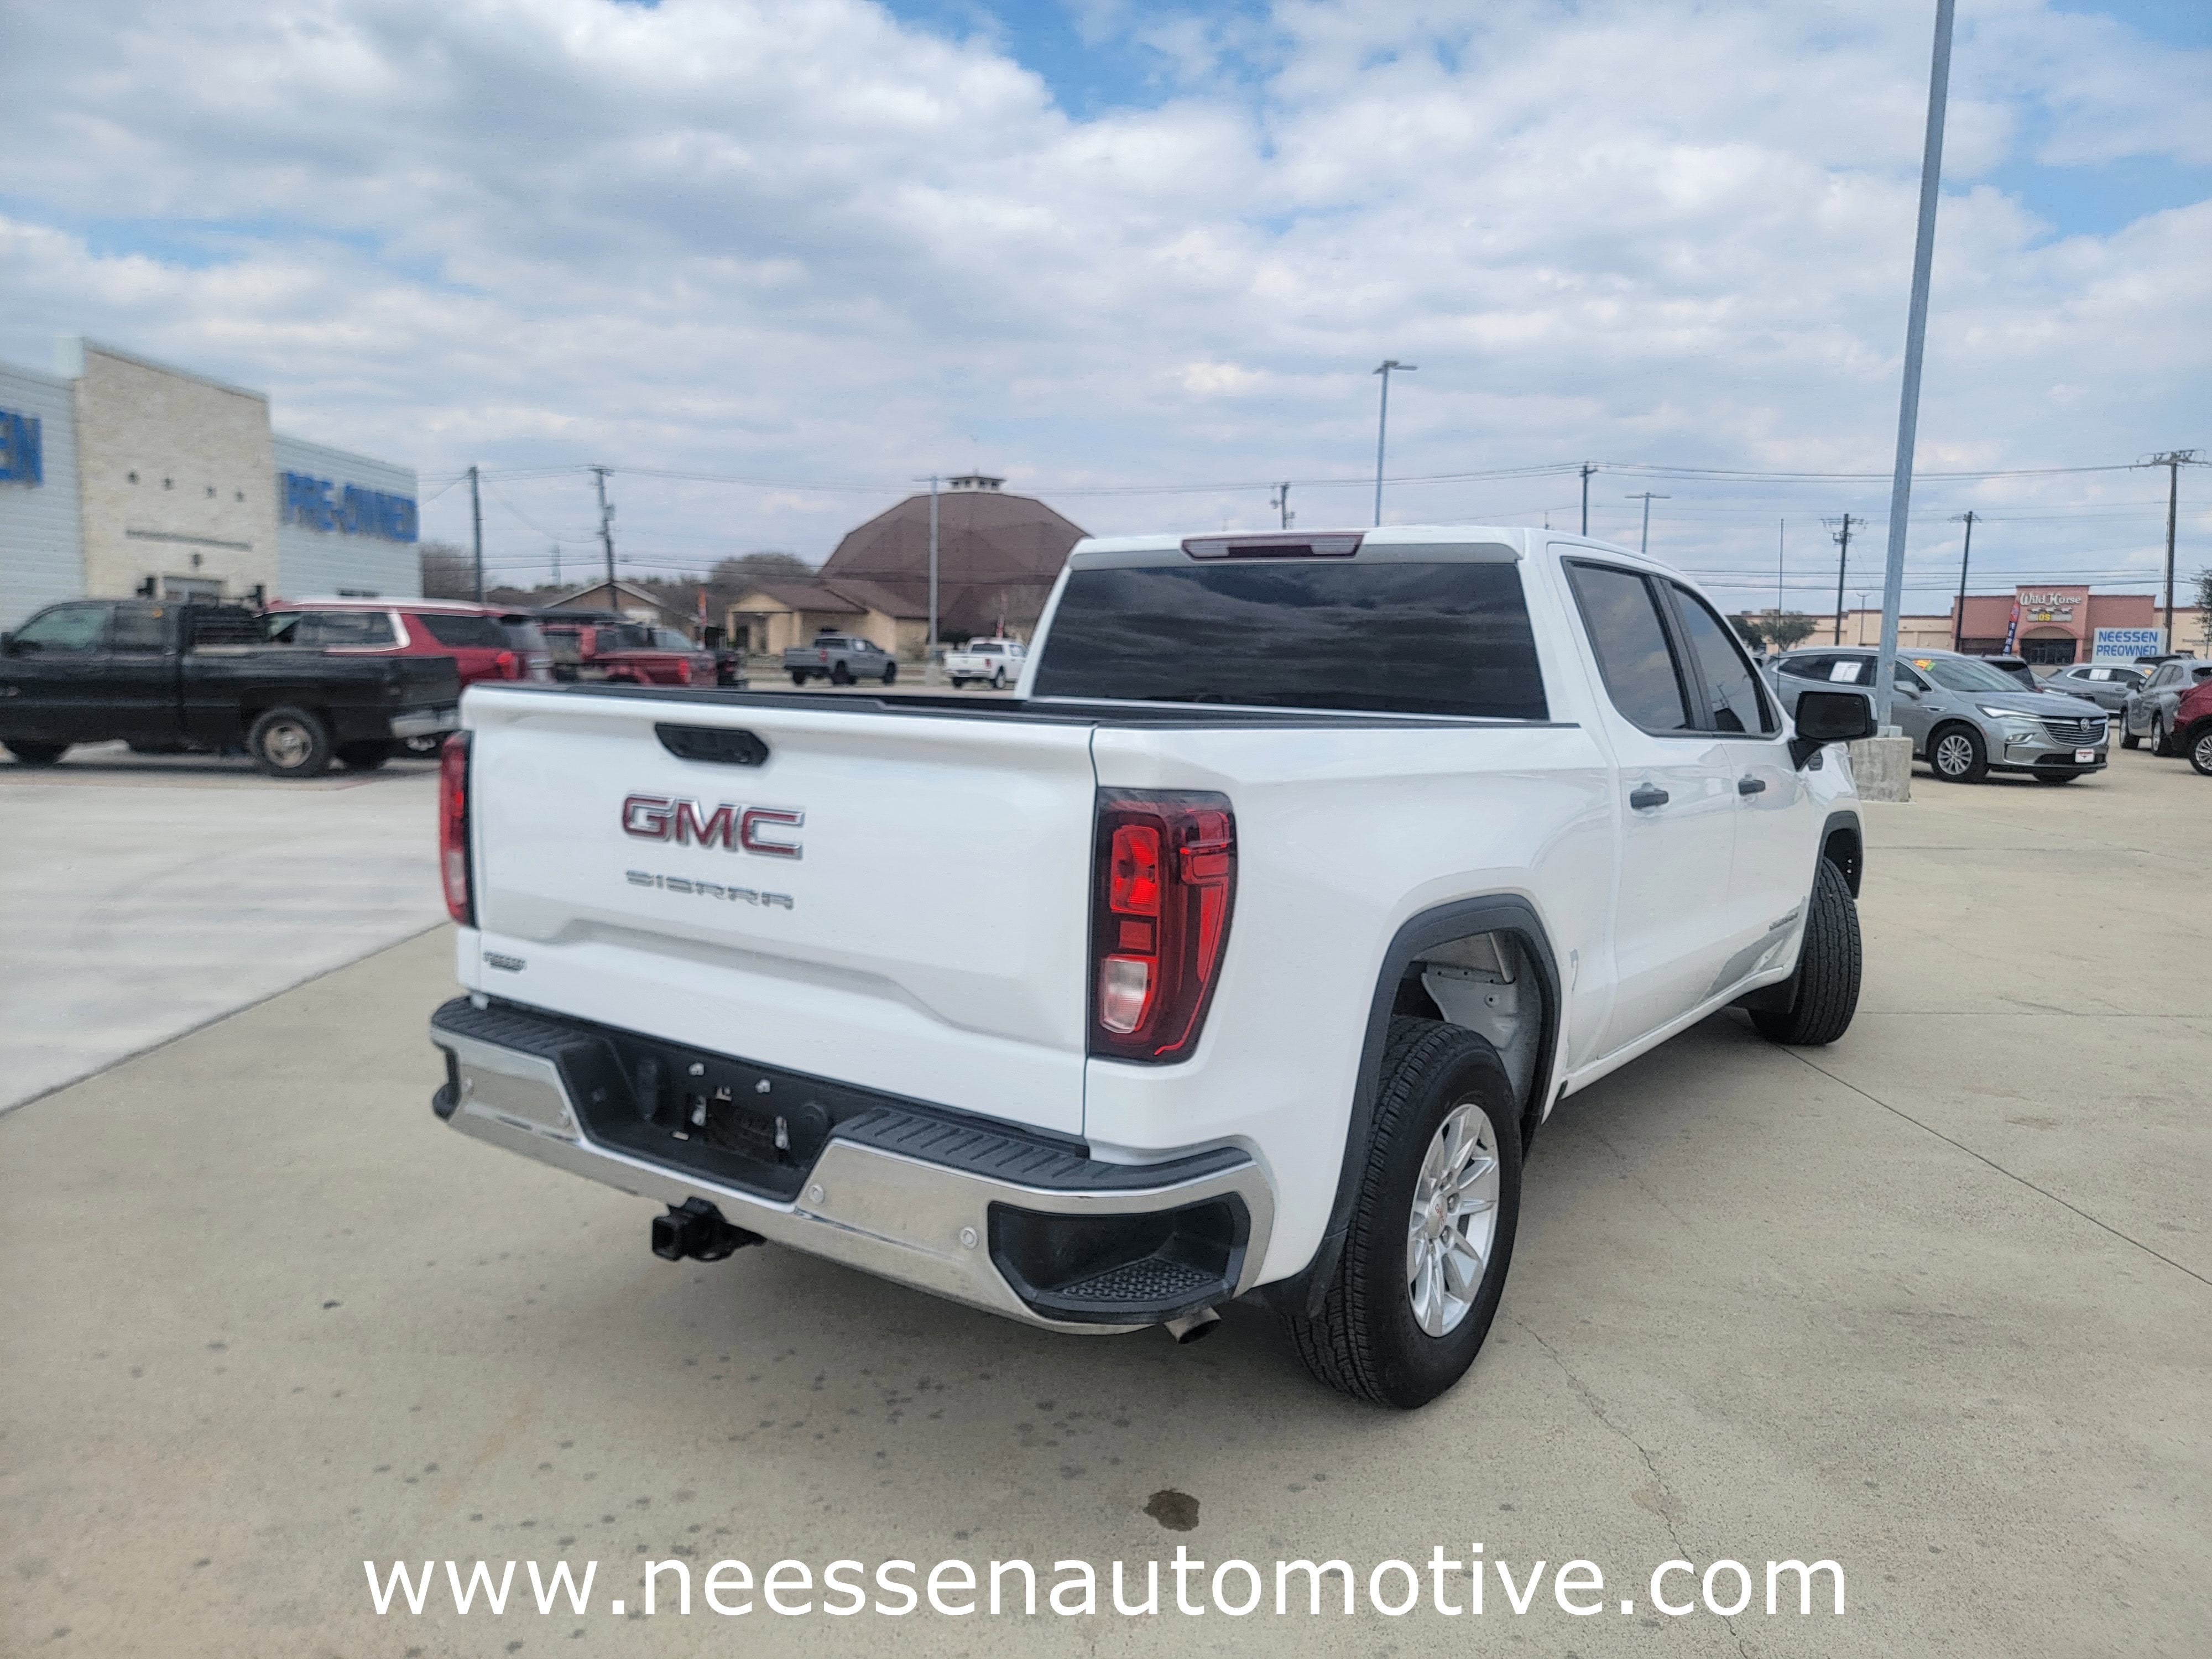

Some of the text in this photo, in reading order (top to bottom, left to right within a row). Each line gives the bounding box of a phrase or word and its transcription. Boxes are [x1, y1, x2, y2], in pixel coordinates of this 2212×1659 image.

[2019, 592, 2081, 606] Wild Horse
[2099, 631, 2158, 643] NEESSEN
[2096, 644, 2157, 656] PREOWNED
[622, 794, 805, 859] GMC
[626, 870, 794, 910] SIERRA
